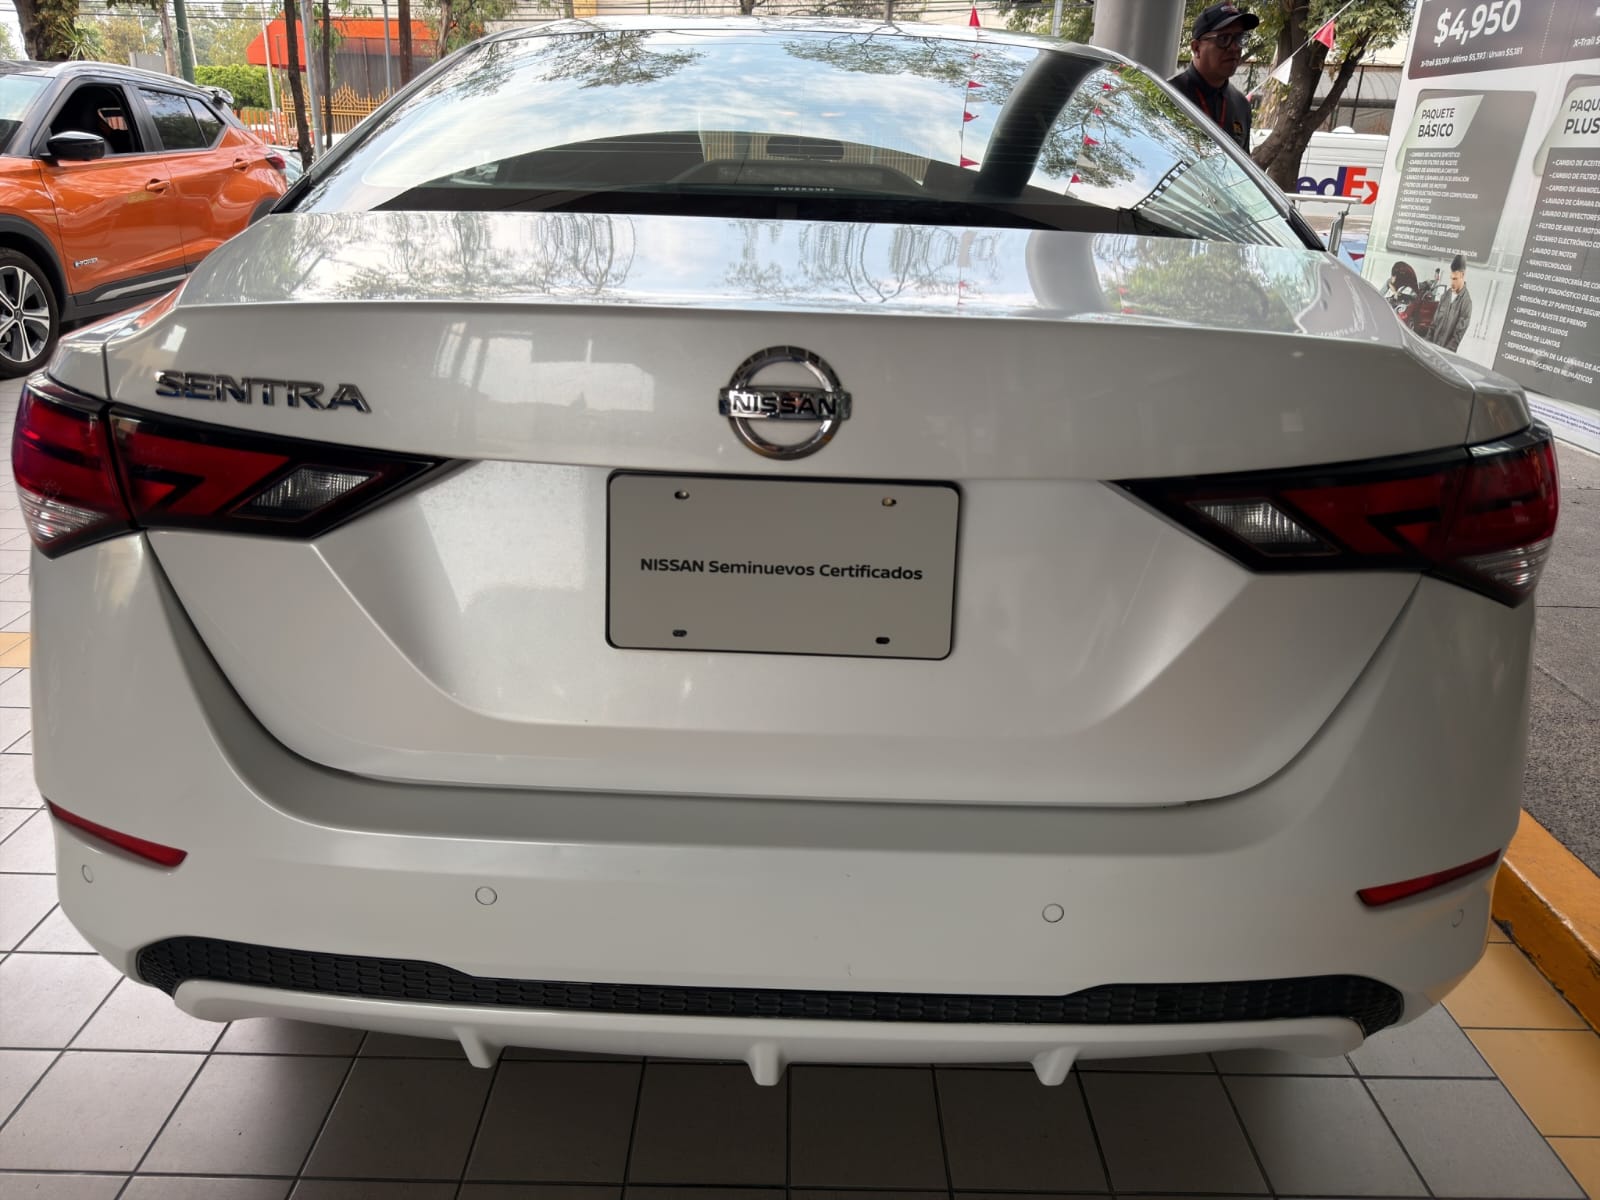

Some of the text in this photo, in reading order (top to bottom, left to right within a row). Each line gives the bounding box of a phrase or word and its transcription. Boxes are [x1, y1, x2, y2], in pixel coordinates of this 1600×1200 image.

[1433, 0, 1521, 47] $4,950
[1421, 107, 1455, 120] PAQUETE
[1570, 98, 1600, 112] PAQU
[1418, 120, 1454, 138] BÁSICO
[1564, 117, 1600, 134] PLUS
[1296, 166, 1379, 204] edEx
[155, 370, 372, 414] SENTRA
[732, 396, 836, 416] NISSAN
[640, 558, 923, 580] NISSAN Seminuevos Certificados
